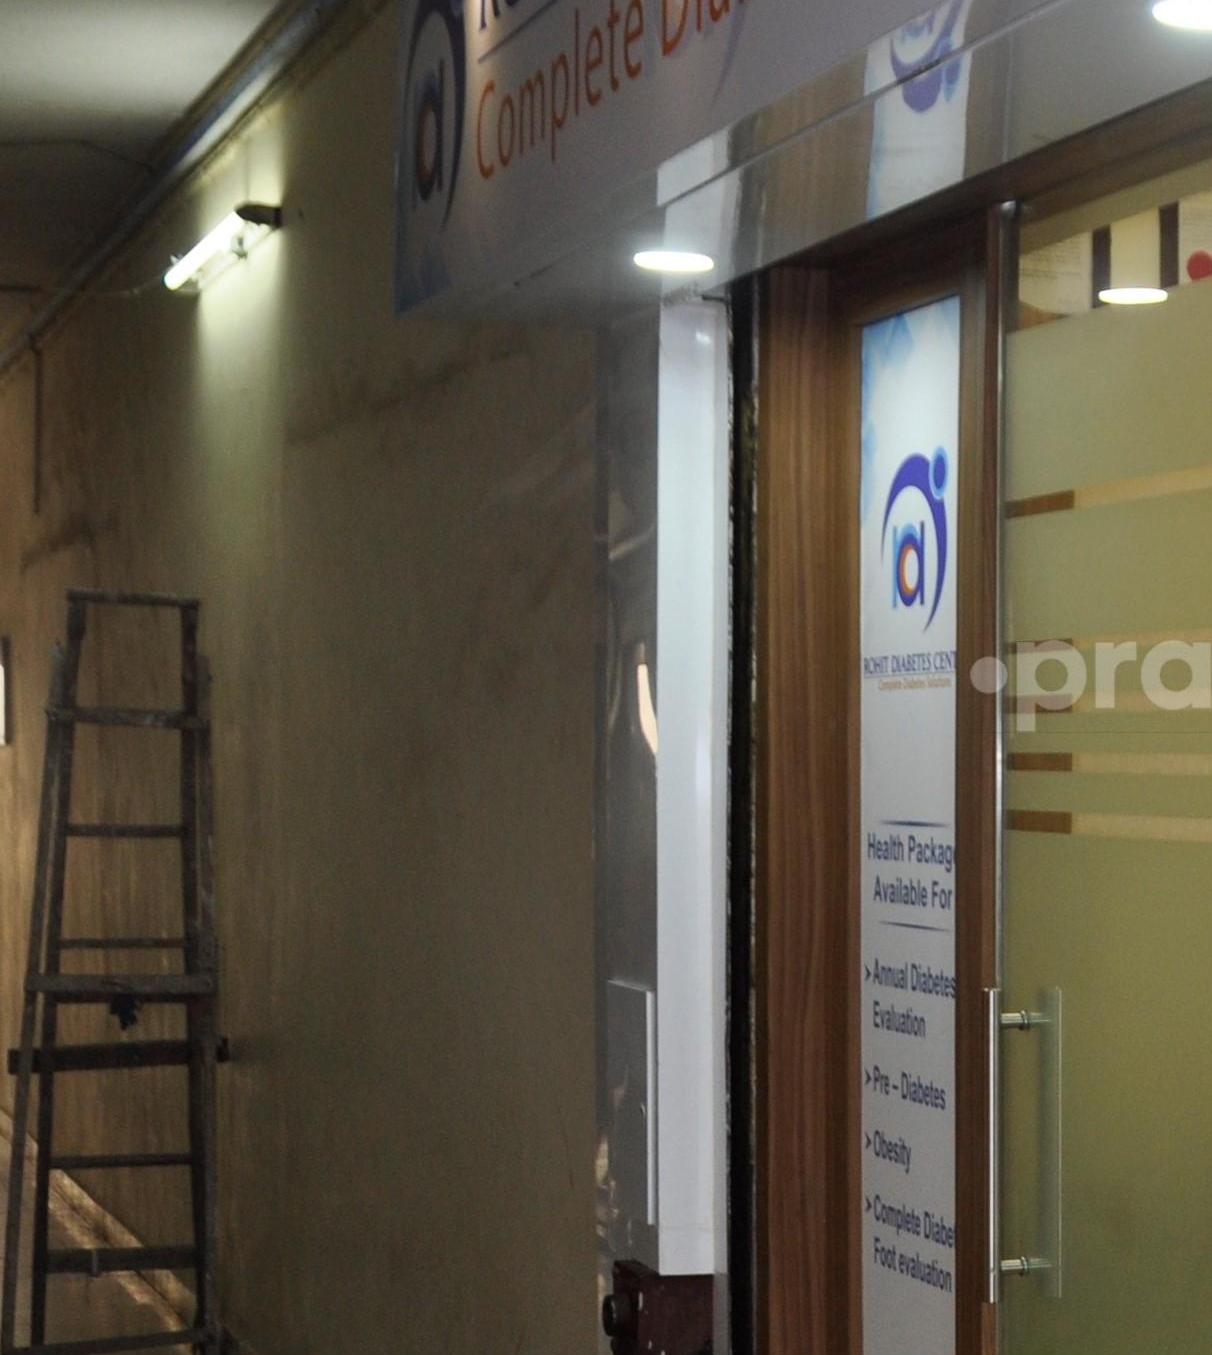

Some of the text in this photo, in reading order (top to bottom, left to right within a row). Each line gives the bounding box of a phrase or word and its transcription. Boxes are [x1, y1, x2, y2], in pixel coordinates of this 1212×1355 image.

[891, 652, 931, 673] DIABETES
[868, 833, 955, 873] Health Packag
[874, 875, 953, 911] Available For
[873, 958, 908, 991] Annual
[873, 1001, 926, 1038] Evaluation
[901, 1072, 946, 1110] Diabetes
[874, 1130, 912, 1173] Obesity
[874, 1195, 955, 1248] Complete Diabe
[874, 1236, 952, 1293] Foot evaluation
